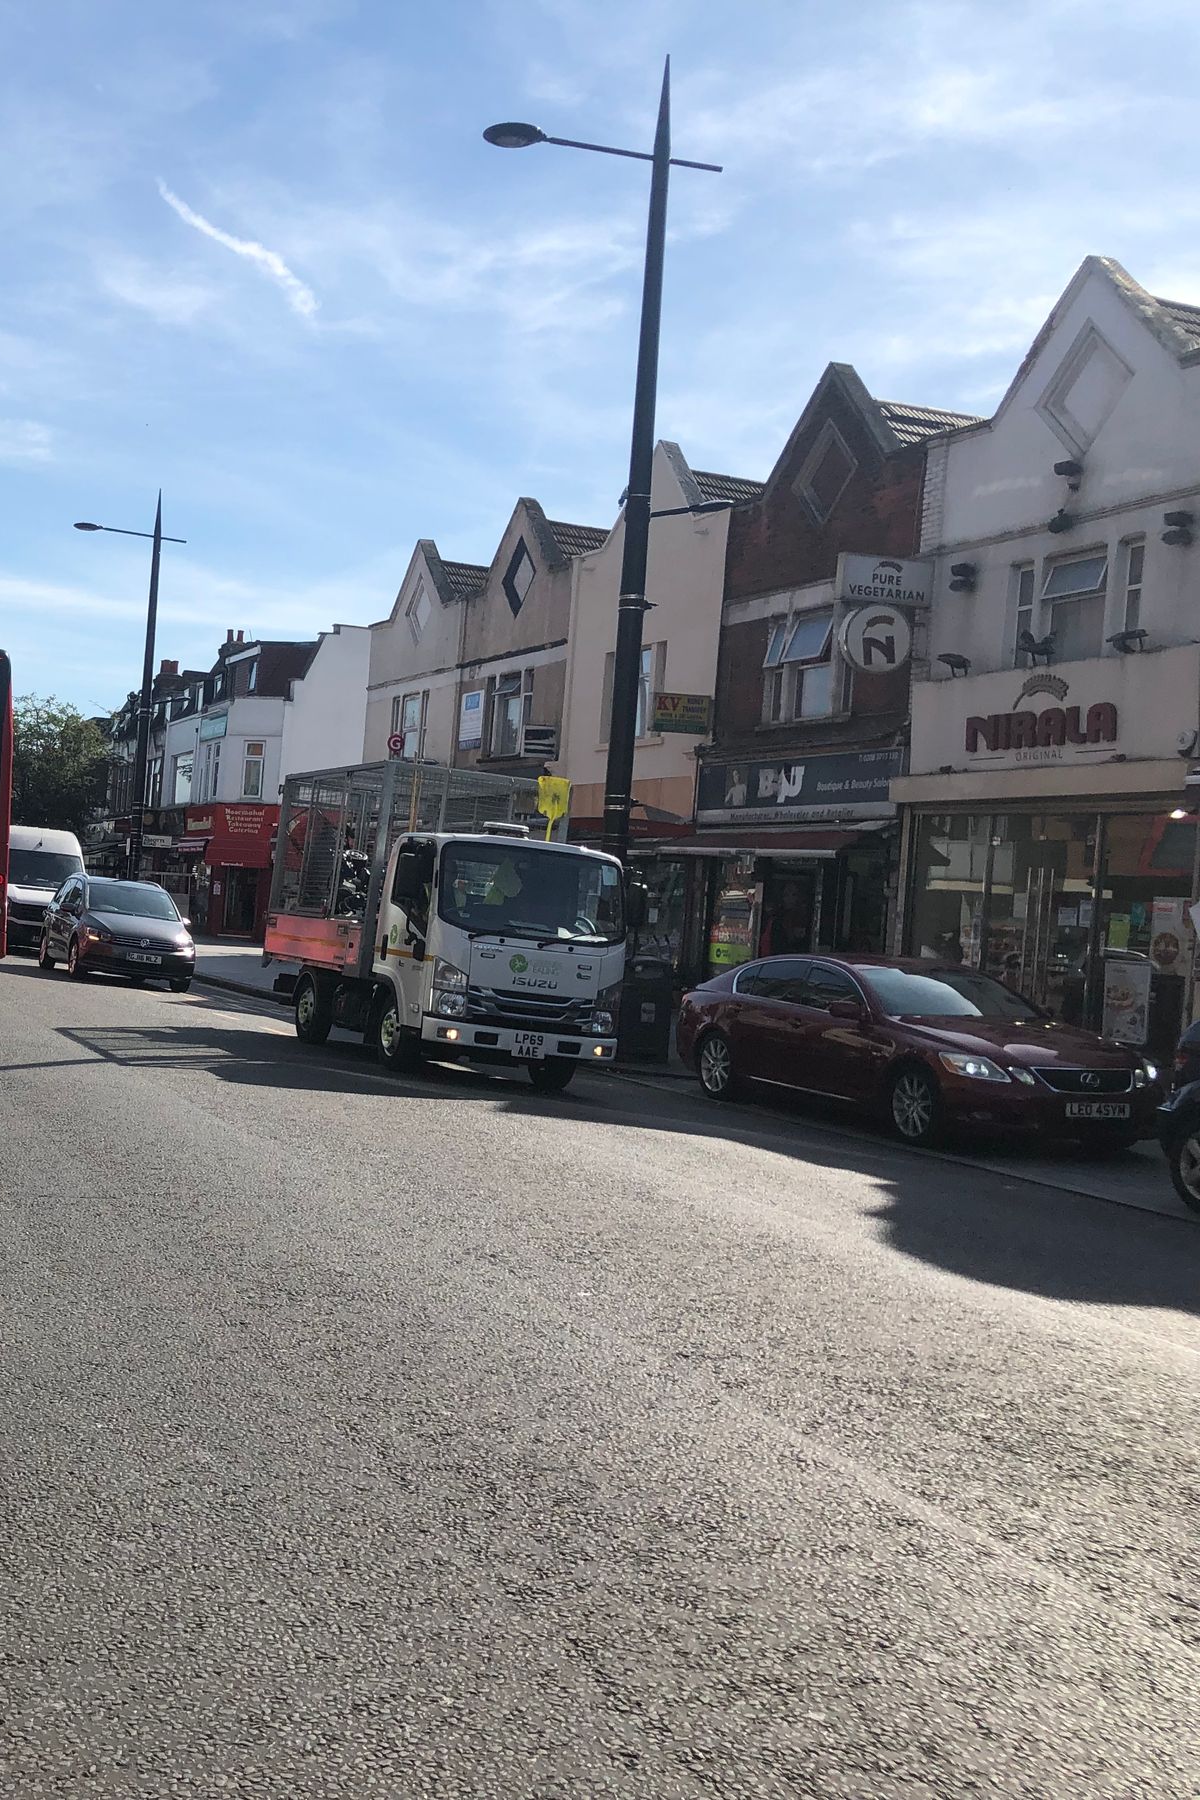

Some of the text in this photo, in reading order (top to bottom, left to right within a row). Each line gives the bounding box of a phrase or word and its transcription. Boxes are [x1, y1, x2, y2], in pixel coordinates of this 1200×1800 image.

[872, 573, 902, 586] PURE
[849, 583, 925, 601] VEGETARIAN
[965, 702, 1118, 752] NIRALA
[1015, 751, 1063, 762] ORIGINAL
[816, 777, 890, 793] Boutique & Beauty Salo
[225, 808, 265, 816] Noormahal
[225, 814, 264, 822] Restaurant
[227, 820, 261, 829] Takeaway
[228, 827, 259, 835] Catering
[512, 976, 558, 990] ISUZU
[515, 1032, 544, 1046] LP69
[517, 1045, 539, 1058] AAE
